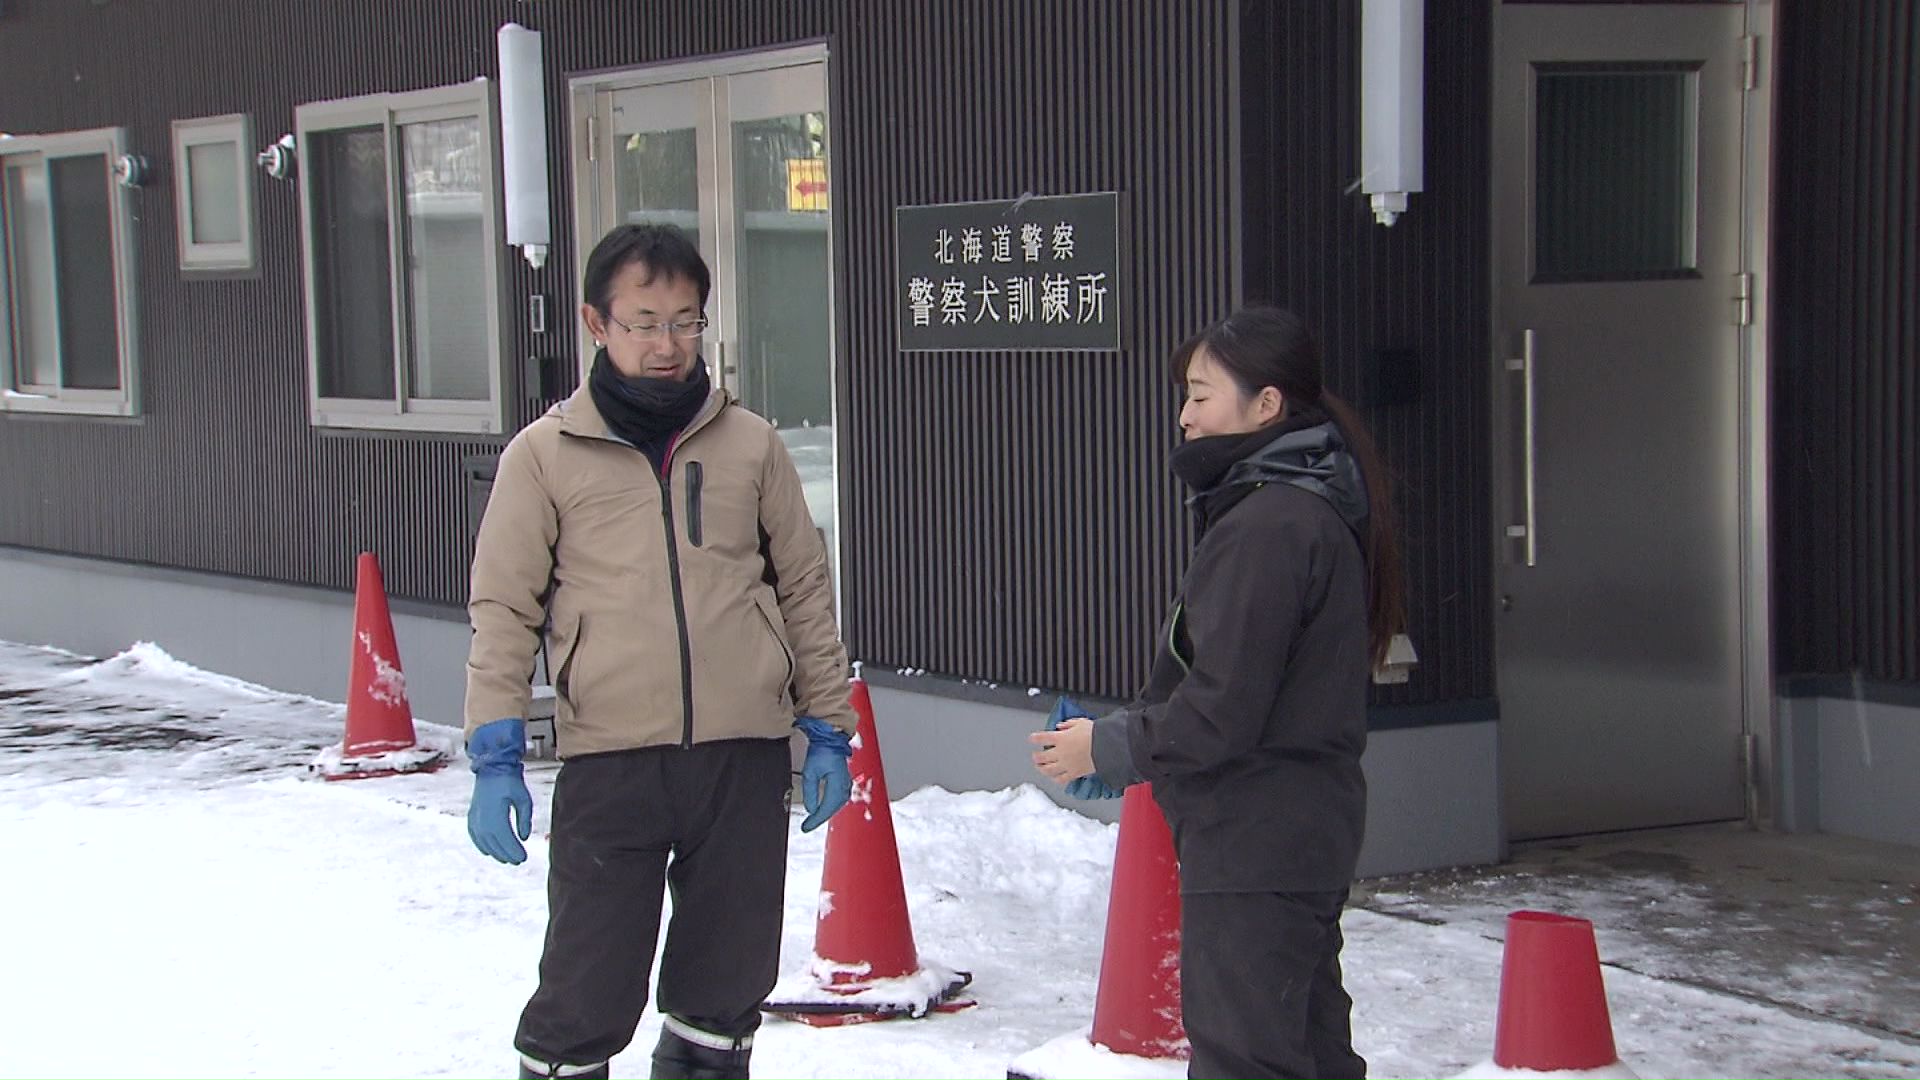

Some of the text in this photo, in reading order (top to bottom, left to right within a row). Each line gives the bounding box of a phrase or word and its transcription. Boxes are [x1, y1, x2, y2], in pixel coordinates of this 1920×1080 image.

[934, 221, 1075, 264] 北海道警察
[908, 272, 1108, 326] 警察犬訓練所
